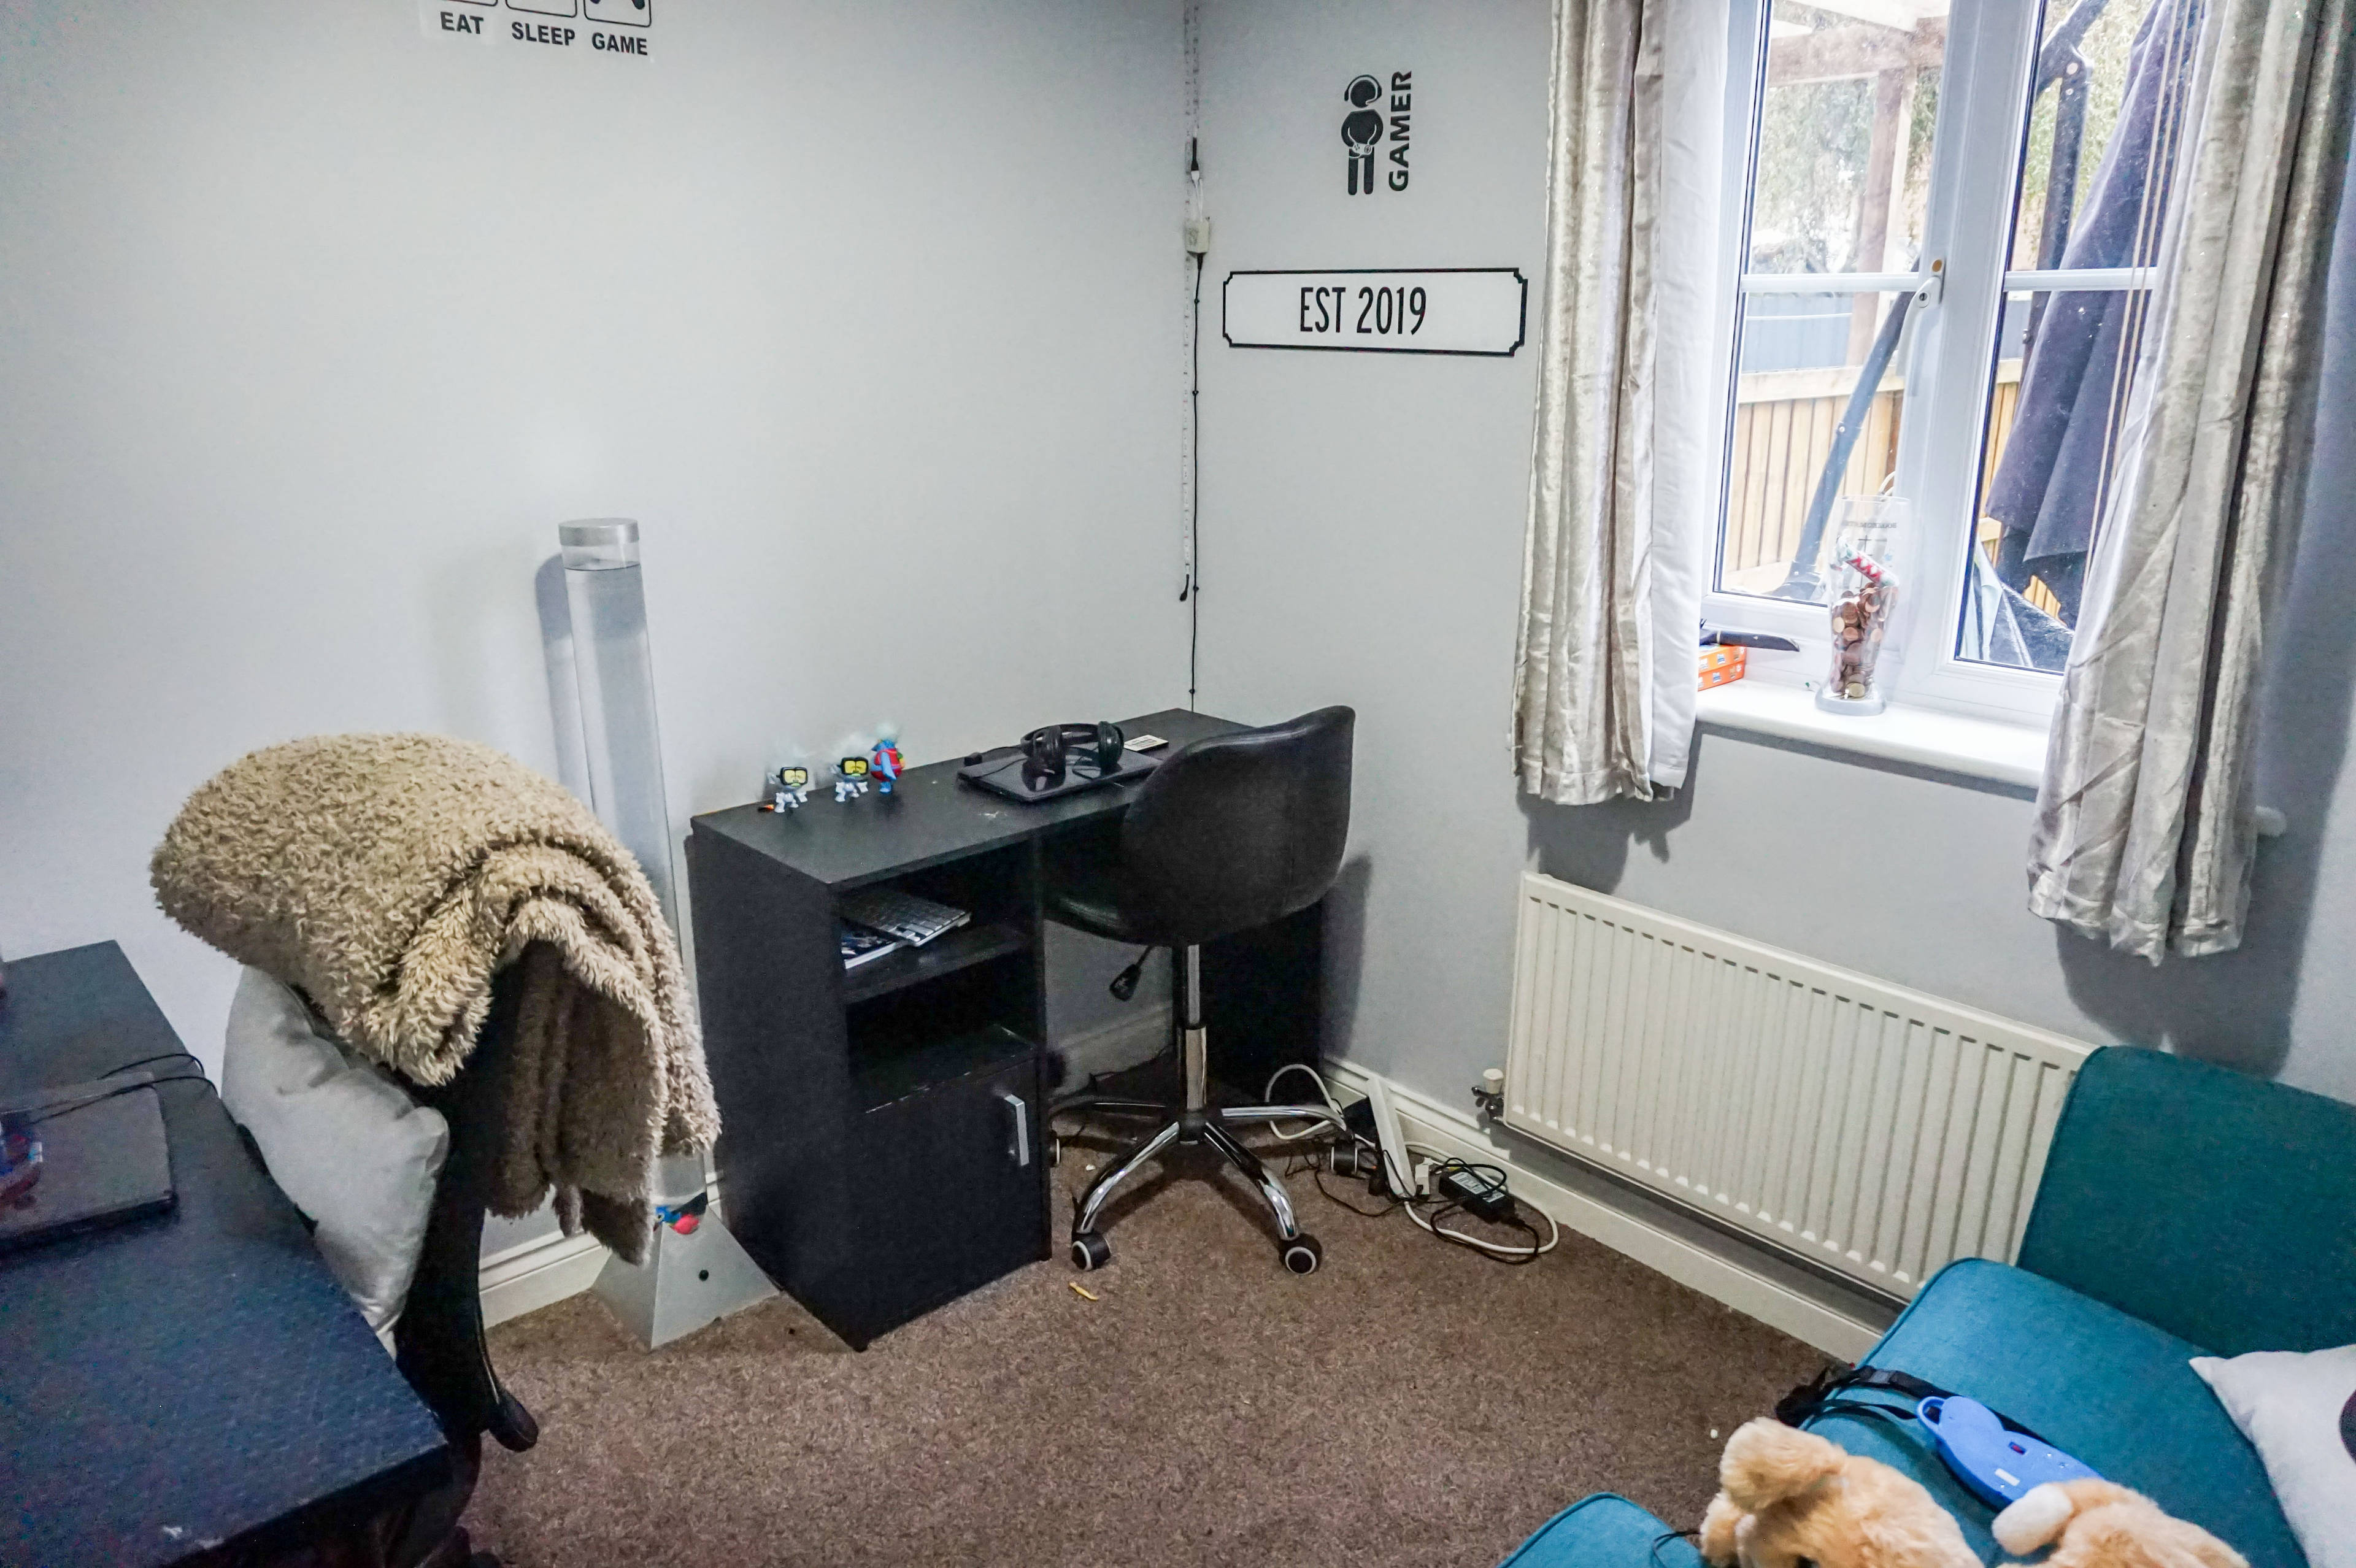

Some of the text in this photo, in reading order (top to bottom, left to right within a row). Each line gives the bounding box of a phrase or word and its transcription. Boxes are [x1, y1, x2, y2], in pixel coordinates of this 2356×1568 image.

[440, 11, 648, 56] EAT SLEEP GAME
[1388, 71, 1412, 192] GAMER
[1300, 286, 1426, 336] EST 2019
